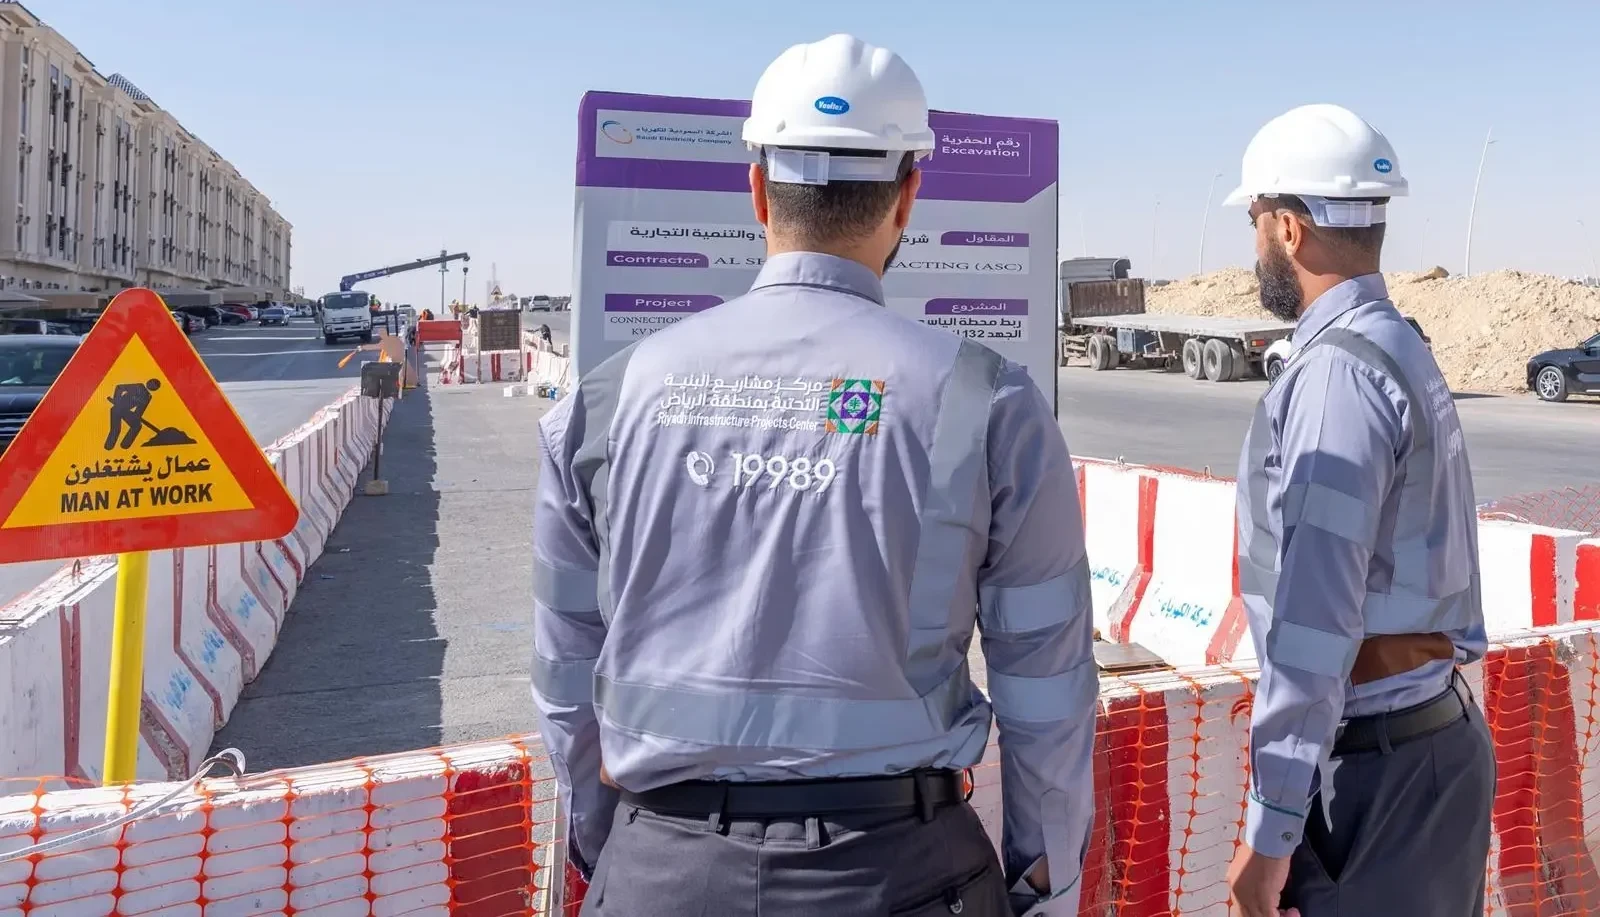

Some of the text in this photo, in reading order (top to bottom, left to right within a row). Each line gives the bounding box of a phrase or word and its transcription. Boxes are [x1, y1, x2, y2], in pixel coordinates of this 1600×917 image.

[636, 134, 732, 146] Saudi Electricity Company
[941, 134, 1021, 149] رقم الحفرية
[942, 146, 1020, 158] Excavation
[630, 226, 689, 239] التجارية
[692, 228, 755, 241] والتنمية
[965, 234, 1015, 244] المقاول
[900, 233, 929, 246] شرك
[613, 254, 700, 265] Contractor
[714, 256, 740, 266] AL
[890, 260, 970, 270] ACTING
[975, 261, 1024, 272] (ASC)
[635, 298, 692, 309] Project
[951, 302, 1007, 313] المشروع
[958, 317, 998, 326] محطة
[999, 318, 1022, 329] ربط
[962, 329, 985, 338] 132
[987, 329, 1021, 340] الجهد
[663, 372, 823, 395] مركز مشاريع البنية
[660, 391, 820, 412] التحتية بمنطقة الرياض
[657, 411, 819, 432] Riyadh Infrastructure Projects Center
[64, 454, 211, 486] عمال يشتغلون
[733, 452, 837, 493] 19989
[60, 483, 213, 513] MAN AT WORK
